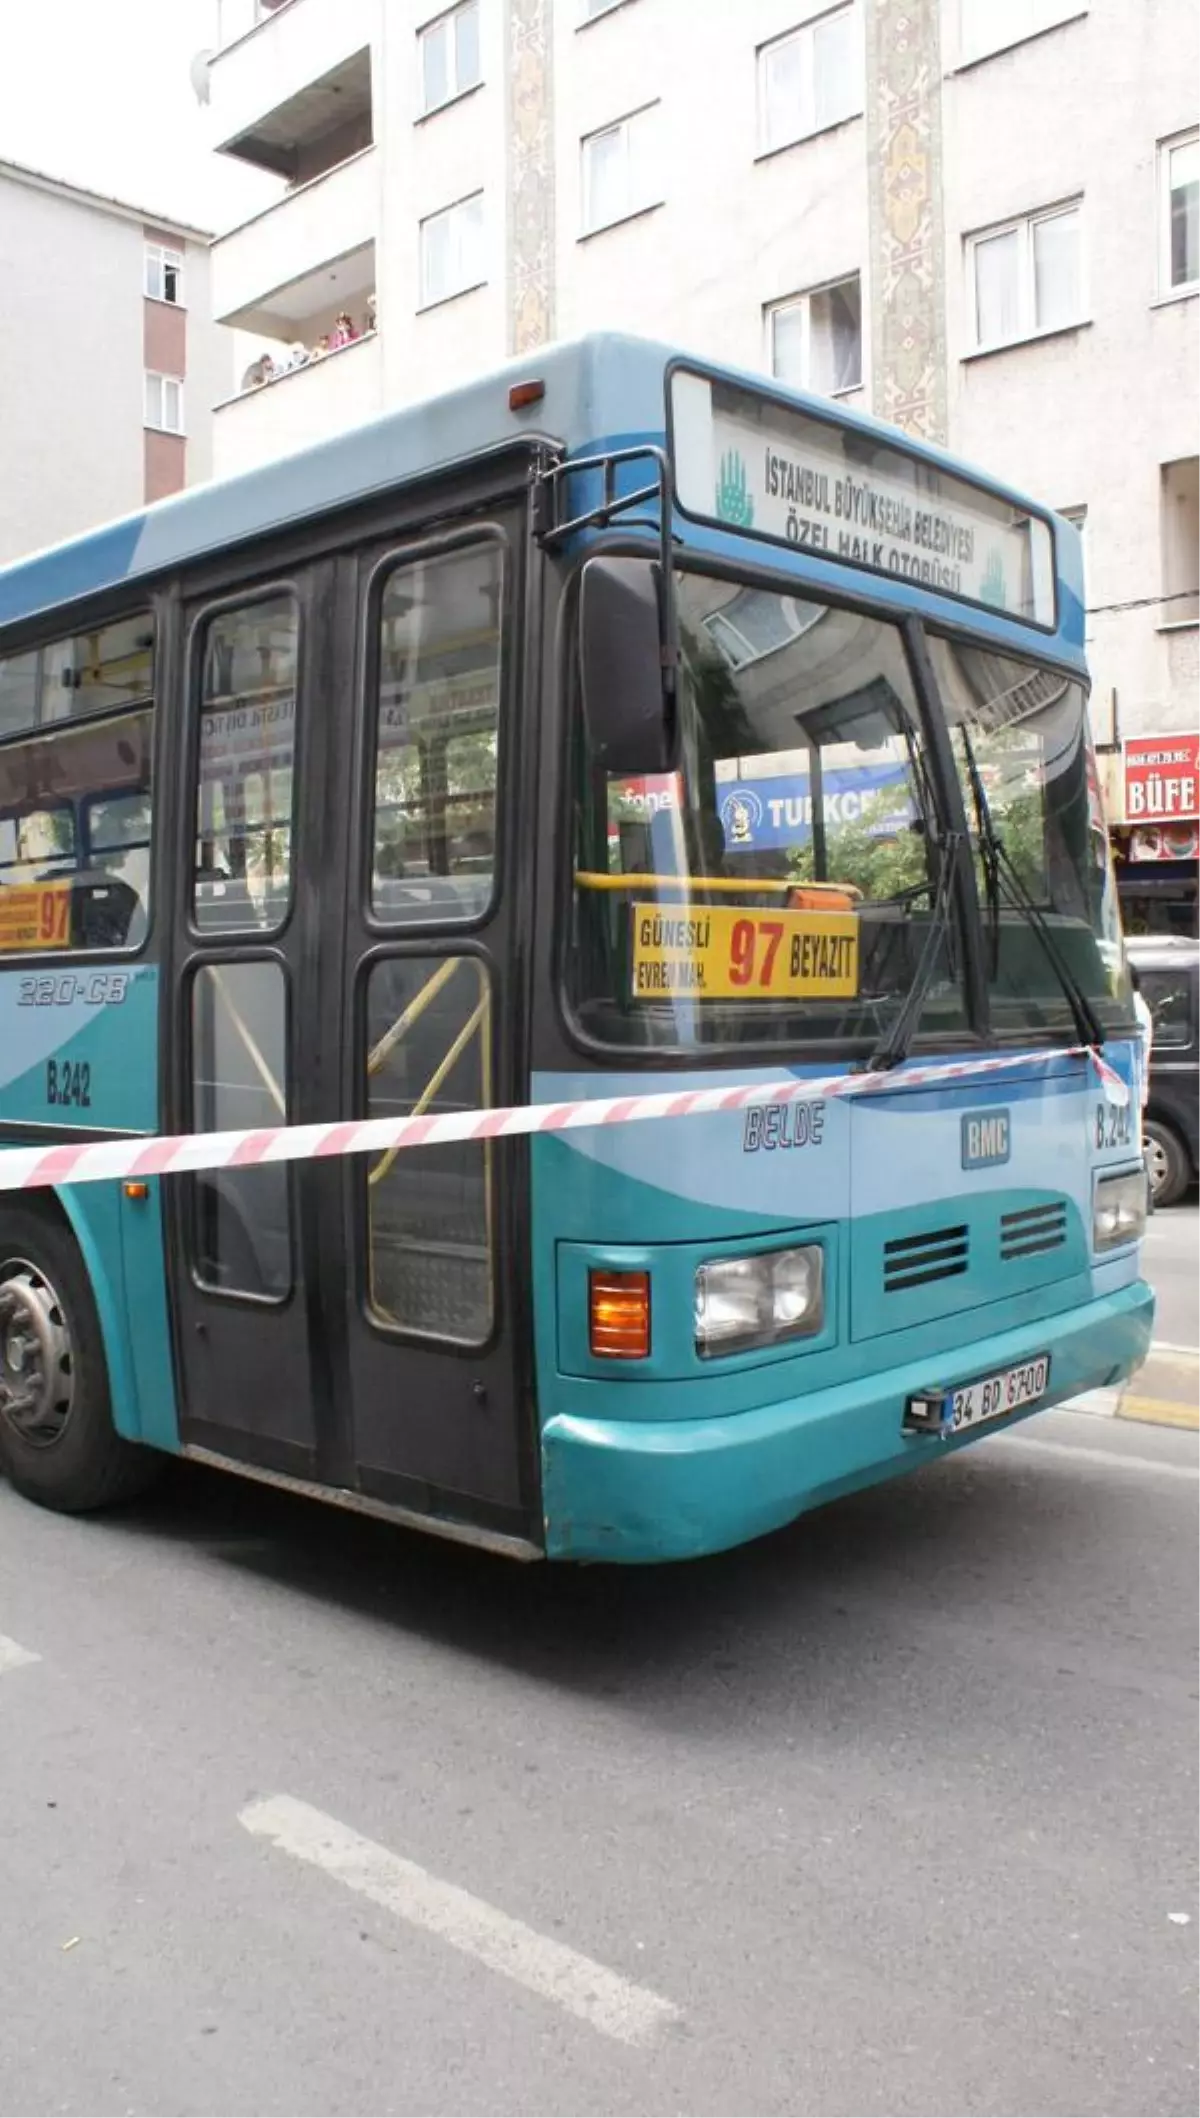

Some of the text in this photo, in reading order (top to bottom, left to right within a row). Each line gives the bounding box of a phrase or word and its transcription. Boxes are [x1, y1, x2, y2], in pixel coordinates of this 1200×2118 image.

[765, 447, 975, 564] İSTANBUL BÜYÜKŞEHİR BELEDİYESİ
[786, 507, 961, 591] ÖZEL HALK OTOBÜSÜ
[766, 789, 908, 828] TUKCE
[1128, 772, 1194, 815] BÜFE
[41, 890, 72, 940] 97
[640, 913, 711, 953] GÜNEŞLİ
[729, 918, 785, 988] 97
[790, 935, 856, 978] BEYAZIT
[17, 974, 130, 1006] 220-CB
[47, 1059, 91, 1107] B.242
[743, 1099, 826, 1152] BELDE
[968, 1116, 1008, 1159] BMC
[1096, 1102, 1131, 1149] B.242
[953, 1391, 973, 1427] 34
[981, 1380, 1001, 1416] BD
